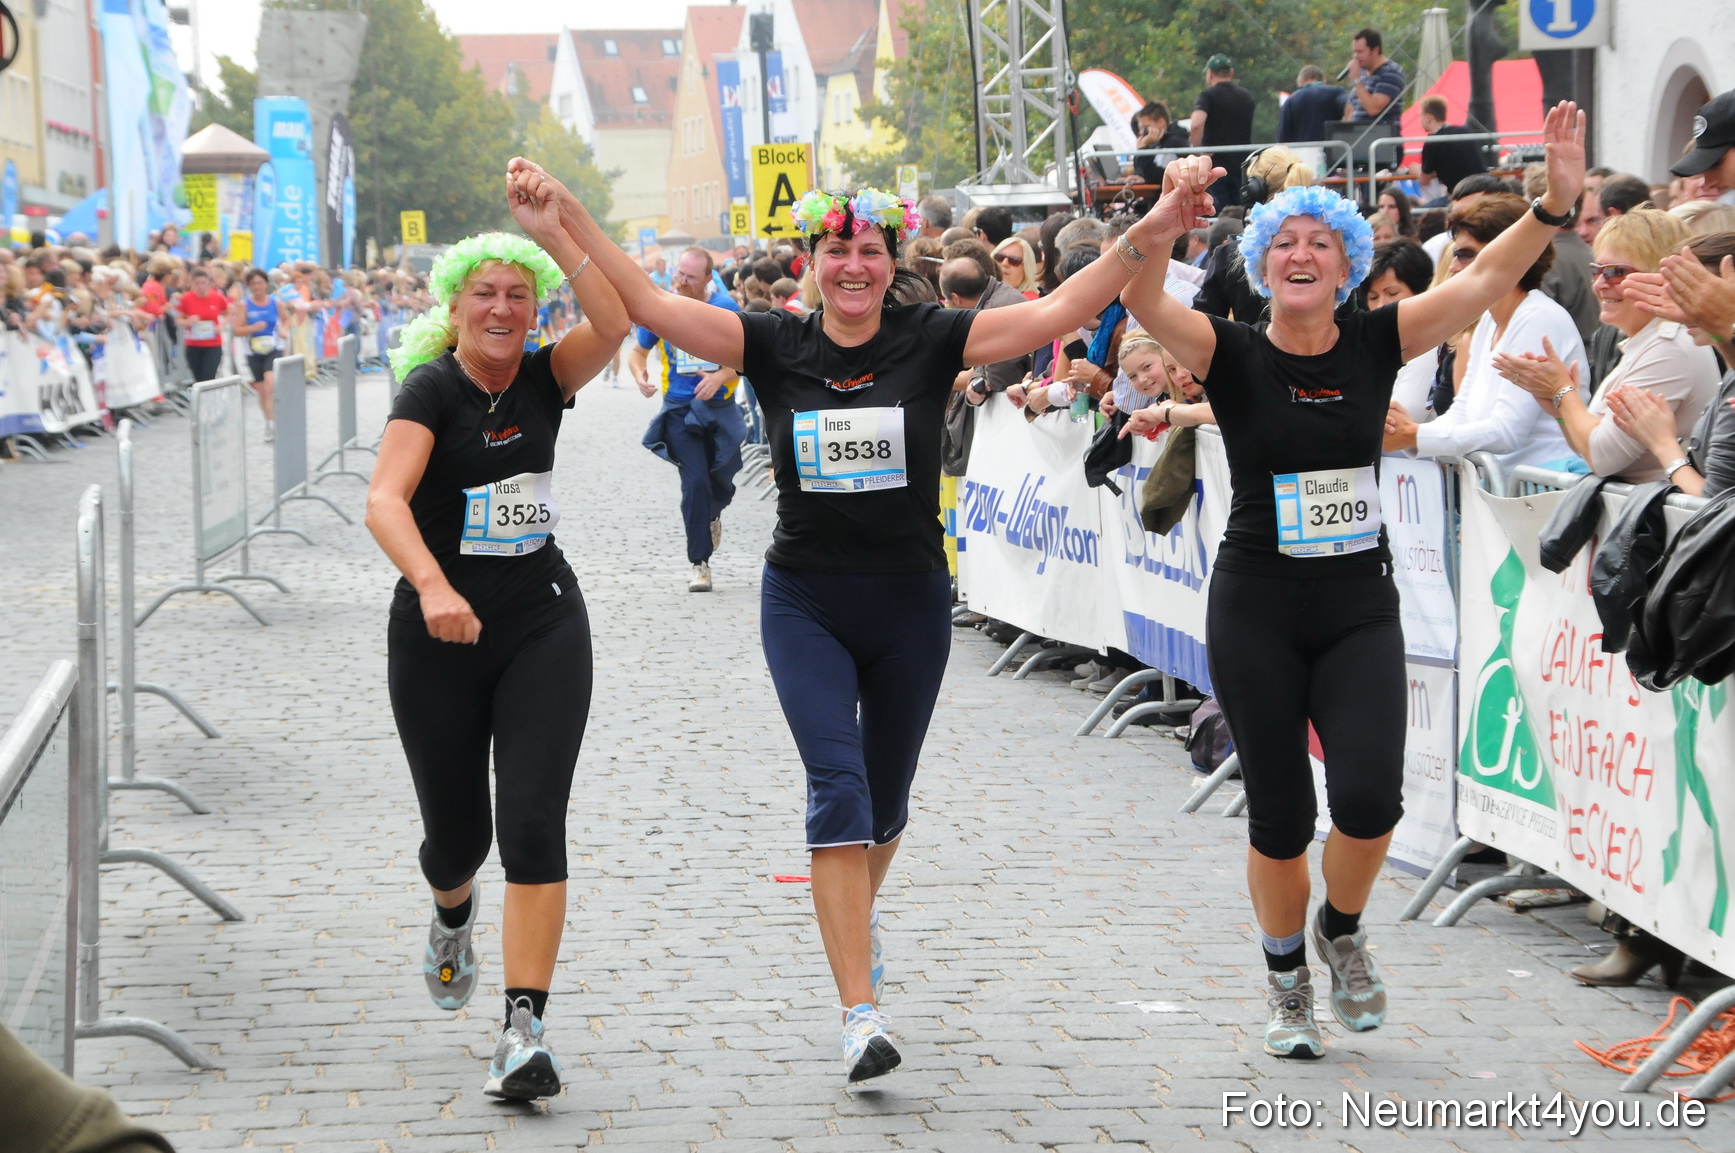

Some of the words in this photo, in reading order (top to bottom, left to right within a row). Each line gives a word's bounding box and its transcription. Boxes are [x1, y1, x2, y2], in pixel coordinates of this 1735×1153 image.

[758, 148, 806, 165] Block
[768, 173, 799, 218] A
[408, 221, 419, 237] B
[736, 213, 747, 229] B
[825, 417, 851, 431] Ines
[802, 442, 808, 453] B
[827, 440, 892, 462] 3538
[864, 473, 905, 486] PFLEIDERER
[1305, 478, 1349, 496] Claudia
[494, 481, 521, 495] Rosa
[472, 504, 479, 516] C
[496, 503, 551, 526] 3525
[1309, 500, 1368, 527] 3209
